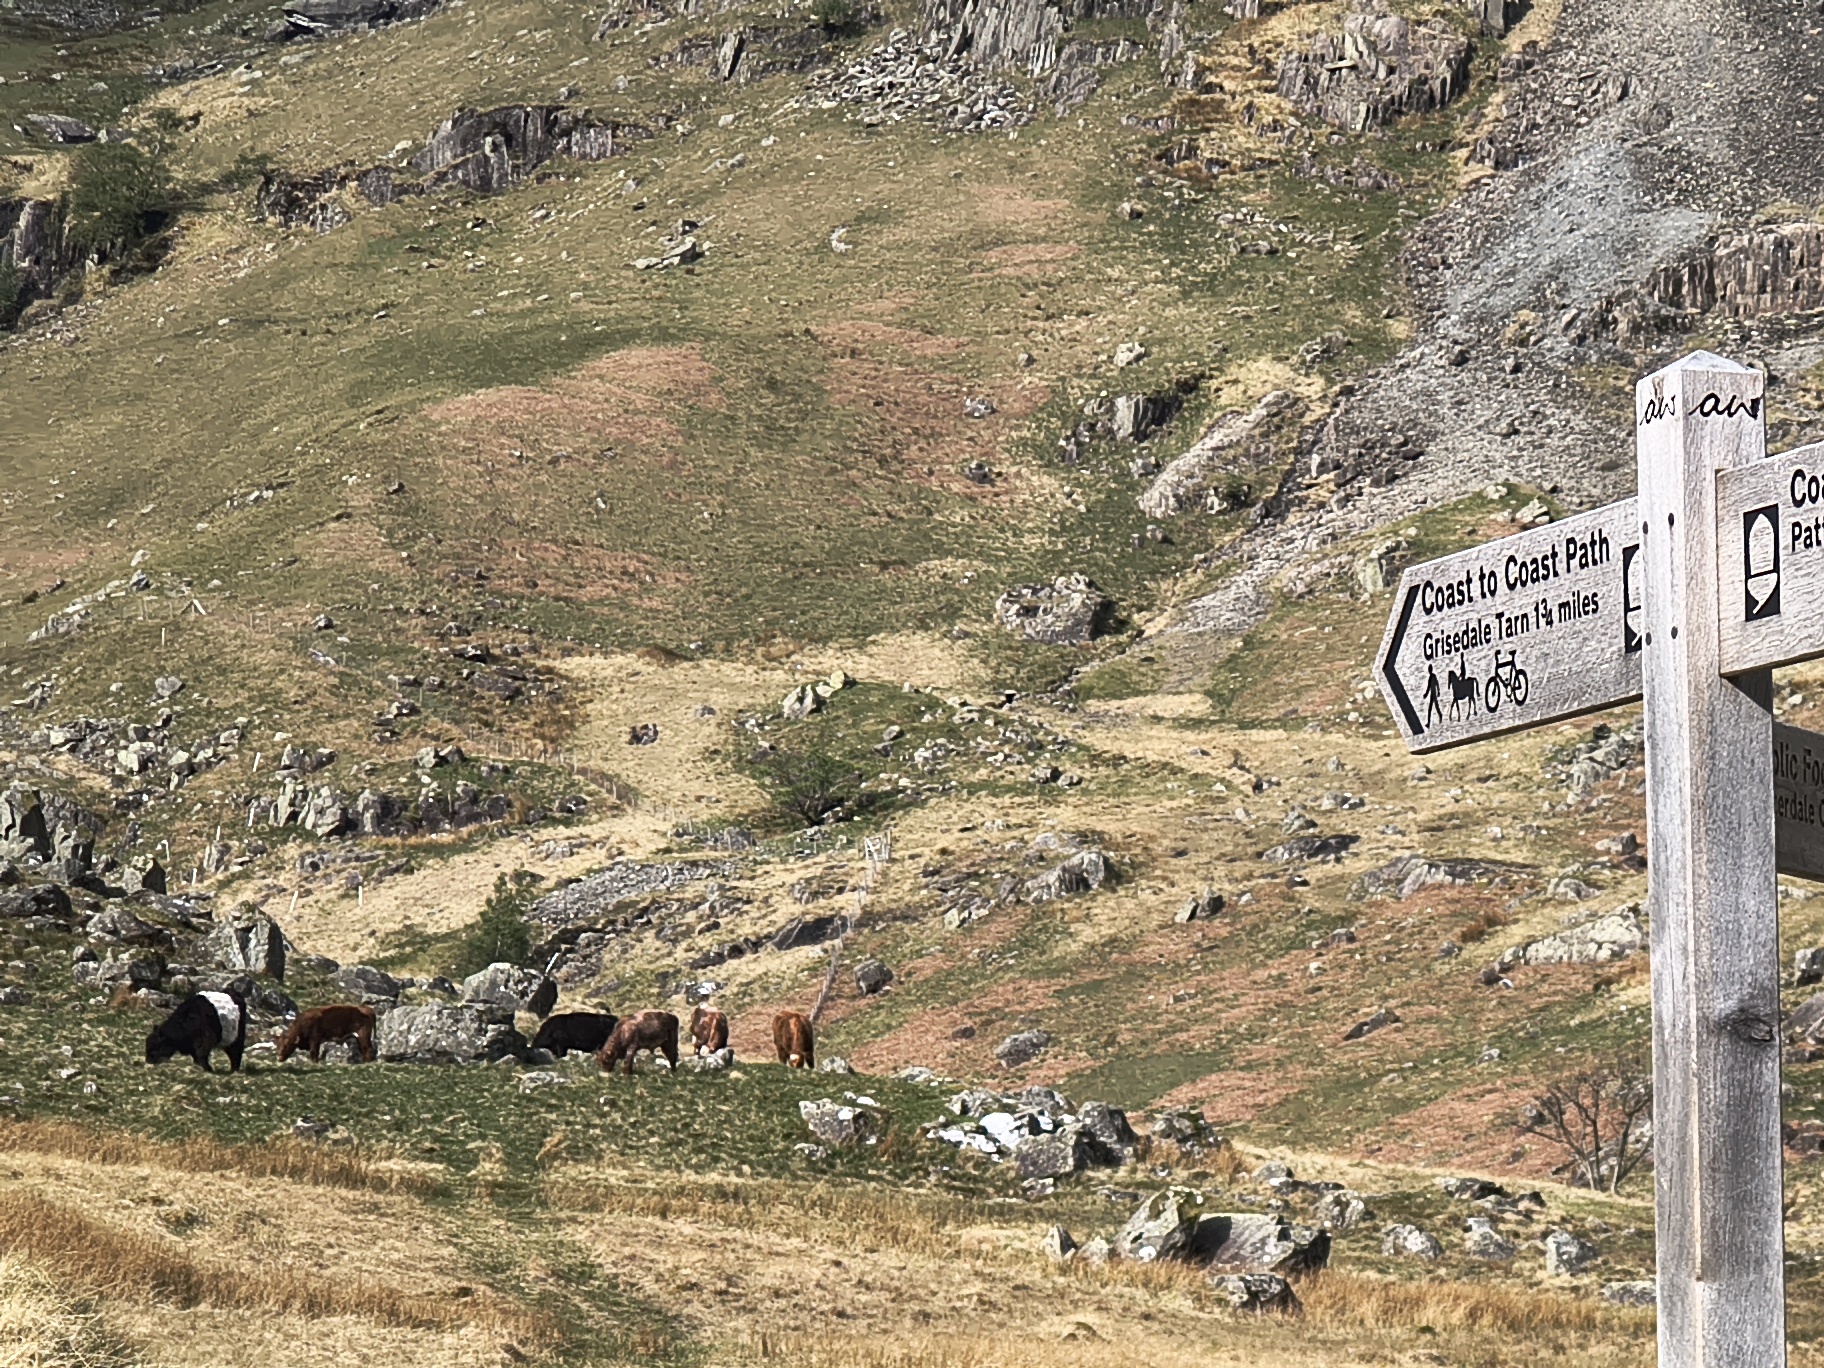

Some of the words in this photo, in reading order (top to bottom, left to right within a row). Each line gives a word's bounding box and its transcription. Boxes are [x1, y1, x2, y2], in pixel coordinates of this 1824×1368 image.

[1421, 570, 1474, 616] Coast
[1478, 565, 1498, 599] to
[1504, 543, 1559, 591] Coast
[1566, 527, 1610, 574] Path
[1423, 618, 1492, 661] Grisedale
[1495, 611, 1530, 640] Tarn
[1558, 590, 1599, 624] miles
